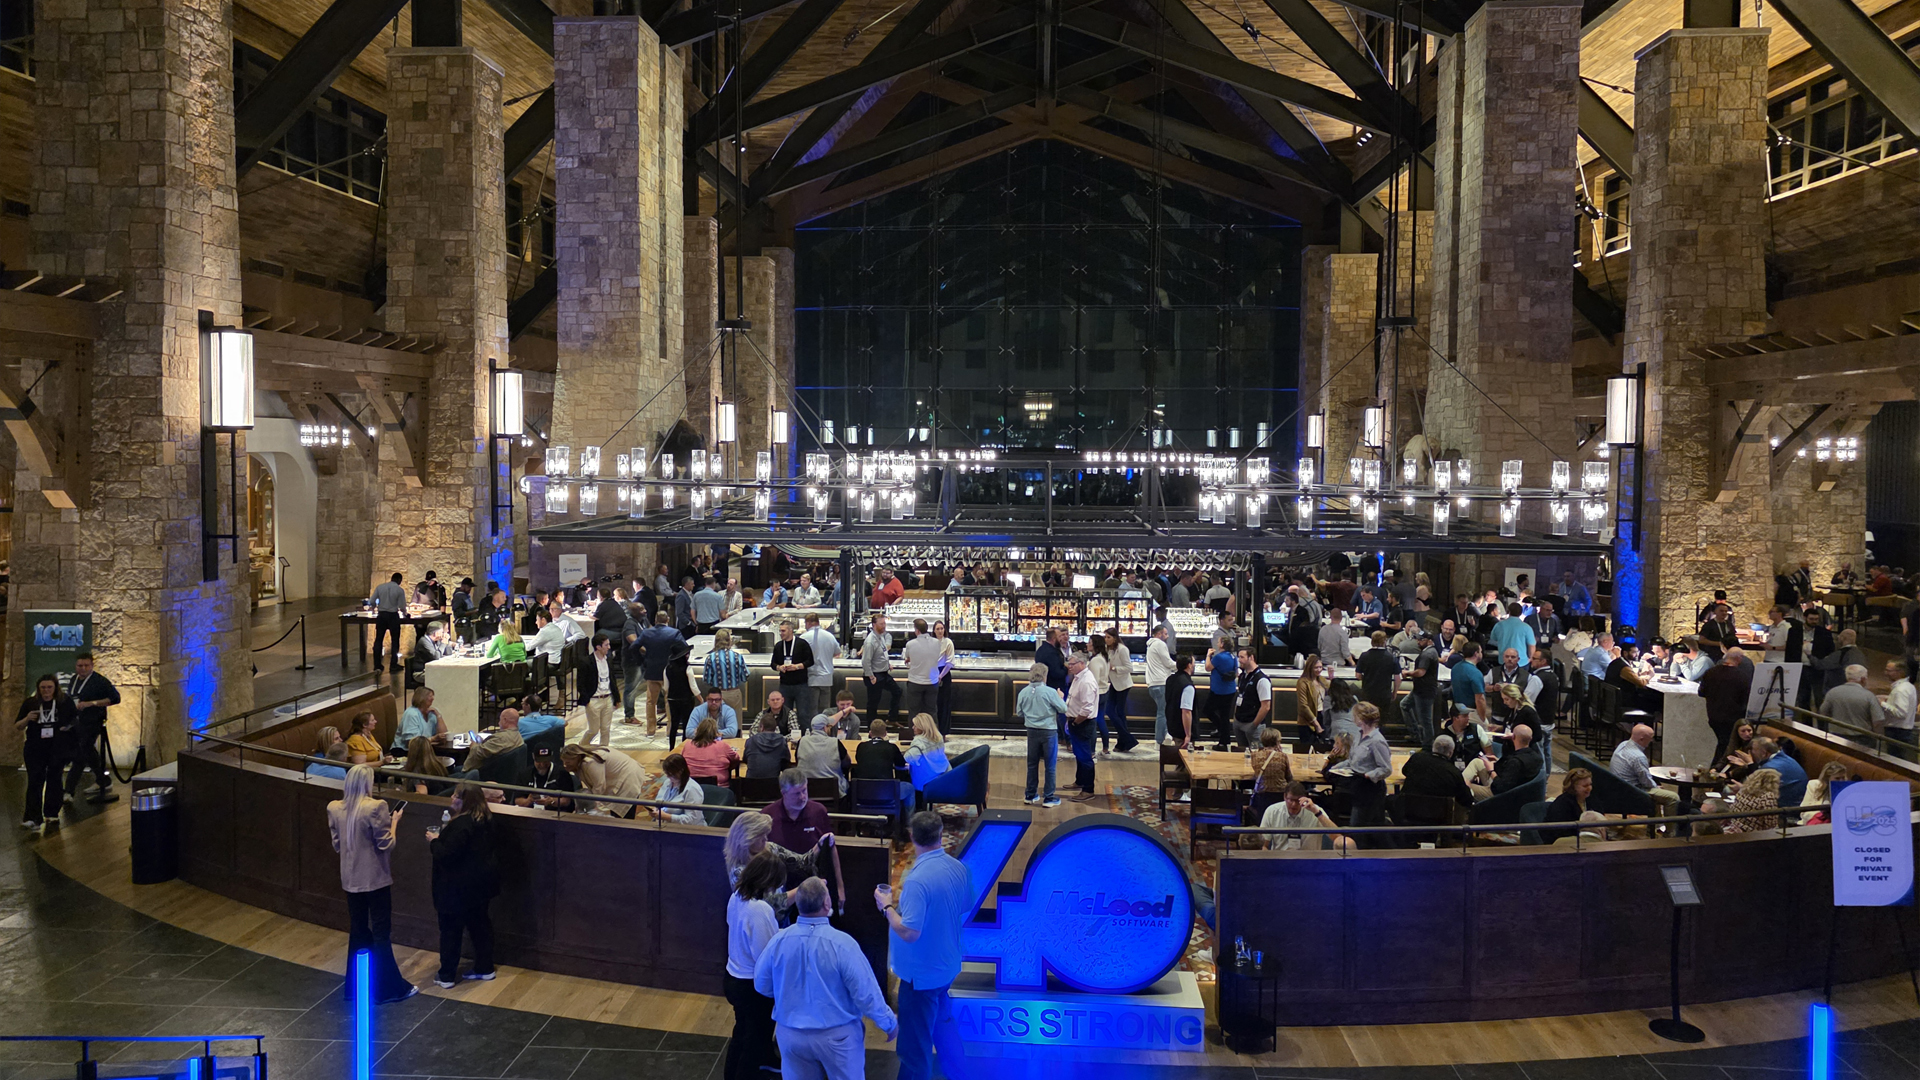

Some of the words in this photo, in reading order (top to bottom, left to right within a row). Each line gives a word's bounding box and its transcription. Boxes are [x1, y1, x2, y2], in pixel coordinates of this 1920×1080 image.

[33, 623, 84, 647] ICE!
[1845, 805, 1897, 836] UC
[1872, 816, 1897, 827] 2025
[1045, 891, 1175, 918] McLeod
[958, 1004, 1030, 1037] ARS
[1039, 1008, 1203, 1045] STRONG
